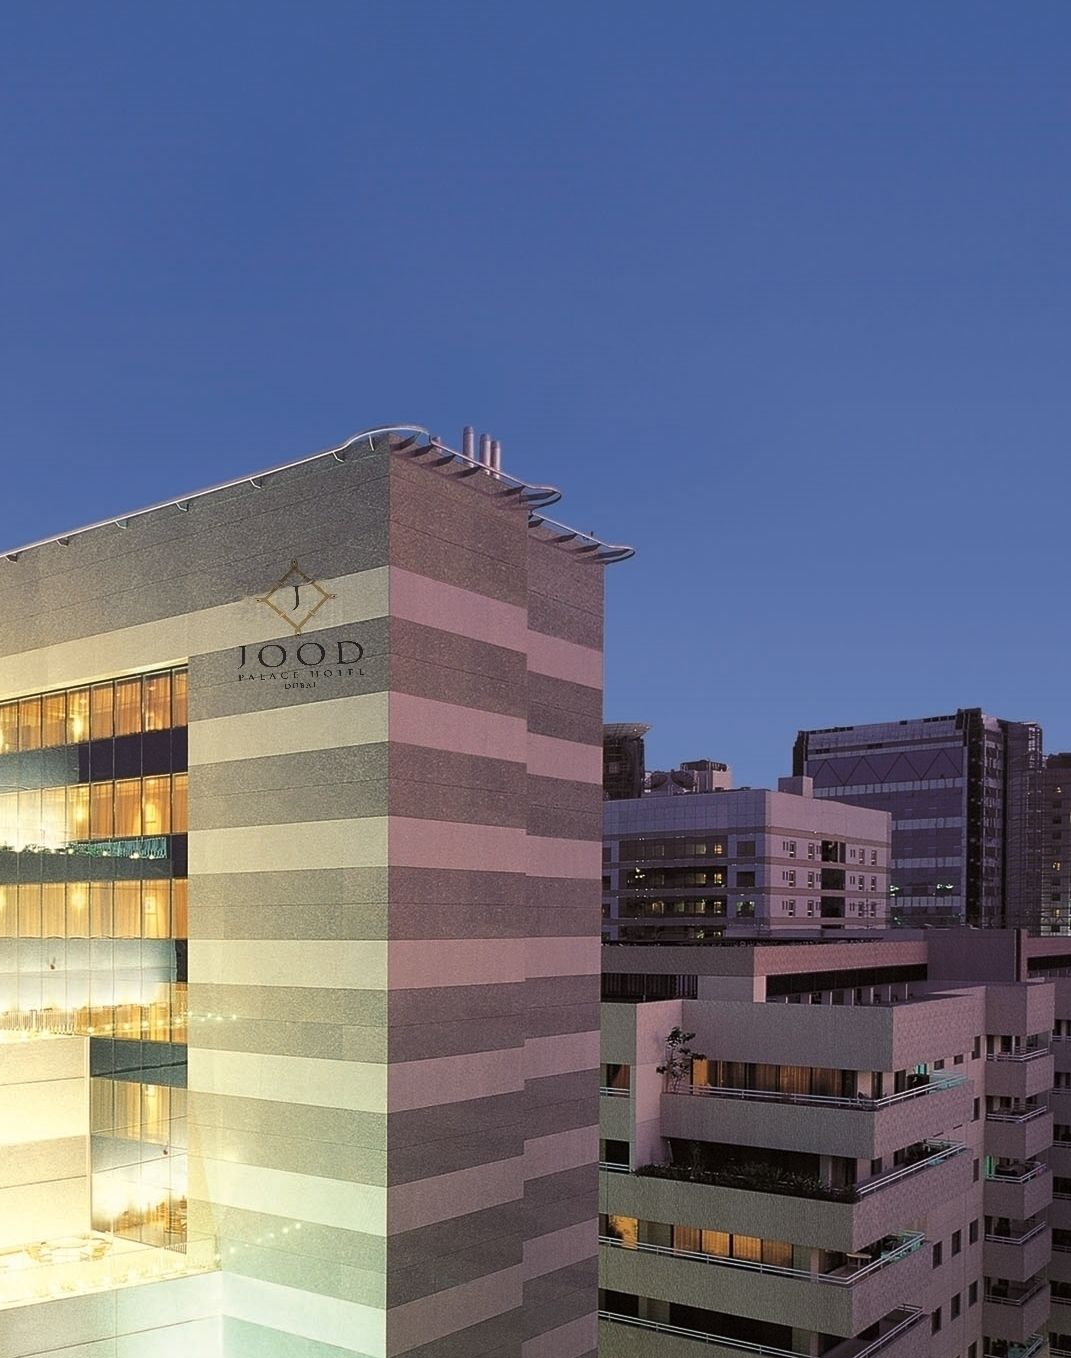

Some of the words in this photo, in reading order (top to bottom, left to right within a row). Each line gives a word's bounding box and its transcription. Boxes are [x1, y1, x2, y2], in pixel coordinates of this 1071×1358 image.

[292, 585, 300, 611] J
[238, 640, 363, 669] JOOD
[238, 671, 299, 682] PALACE
[310, 668, 365, 679] HOTEL
[284, 682, 317, 690] DUBAI
